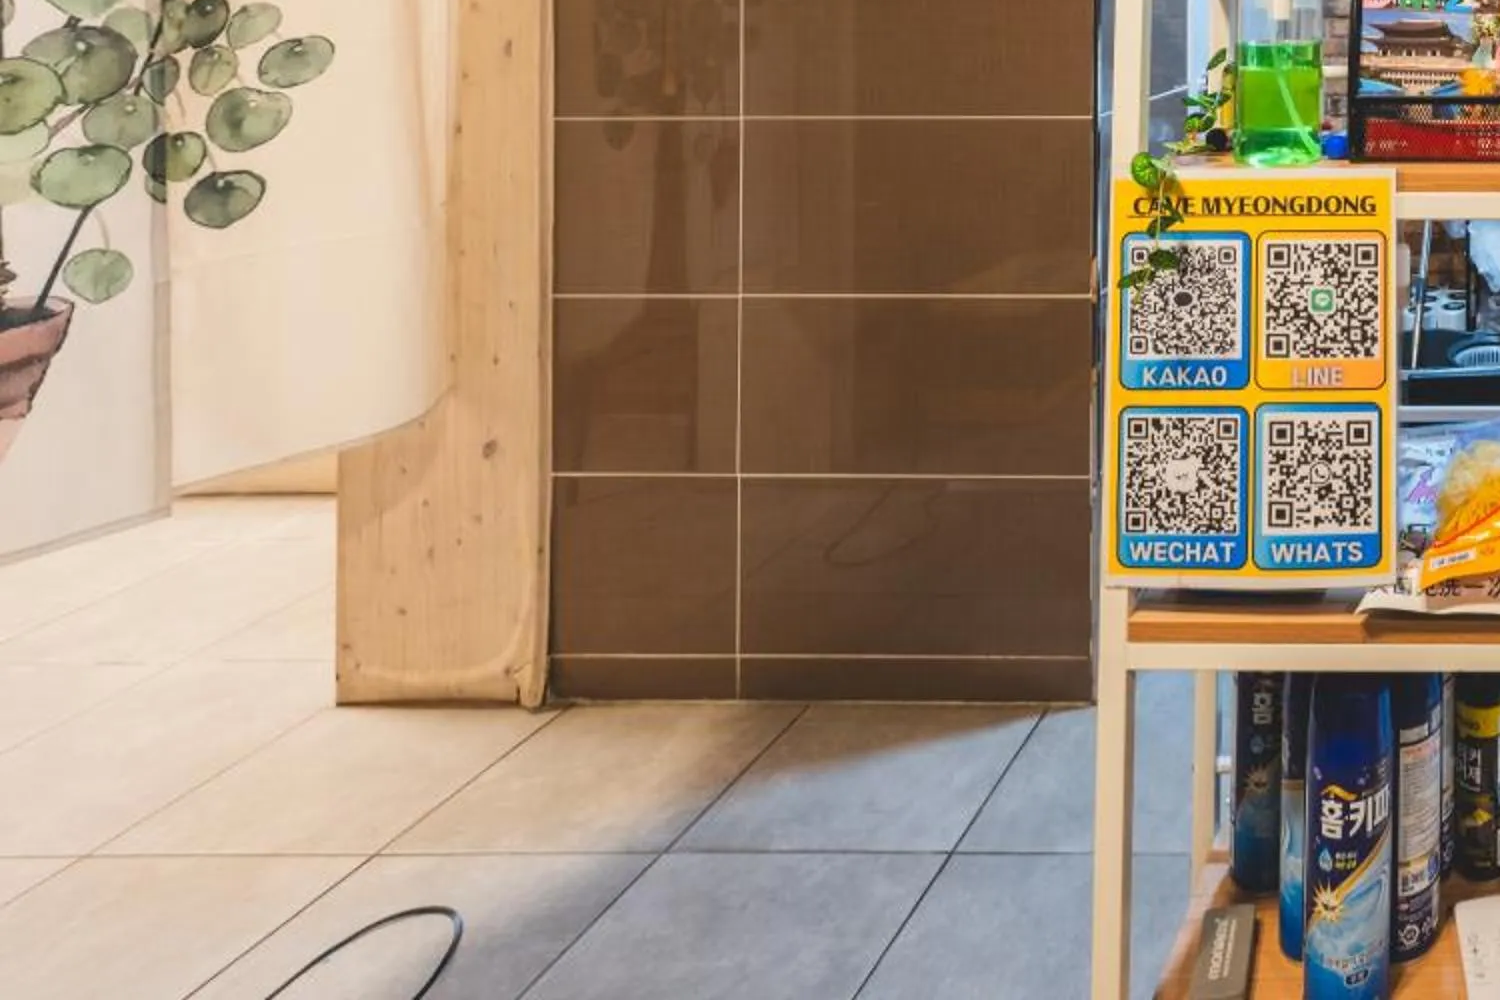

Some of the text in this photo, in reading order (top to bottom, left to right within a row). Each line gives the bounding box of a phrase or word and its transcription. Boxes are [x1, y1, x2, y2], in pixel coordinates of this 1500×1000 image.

[1133, 195, 1377, 216] CAVE MYEONGDONG
[1142, 365, 1228, 388] KAKAO
[1291, 366, 1344, 388] LINE
[1129, 541, 1236, 563] WECHAT
[1271, 541, 1364, 564] WHATS
